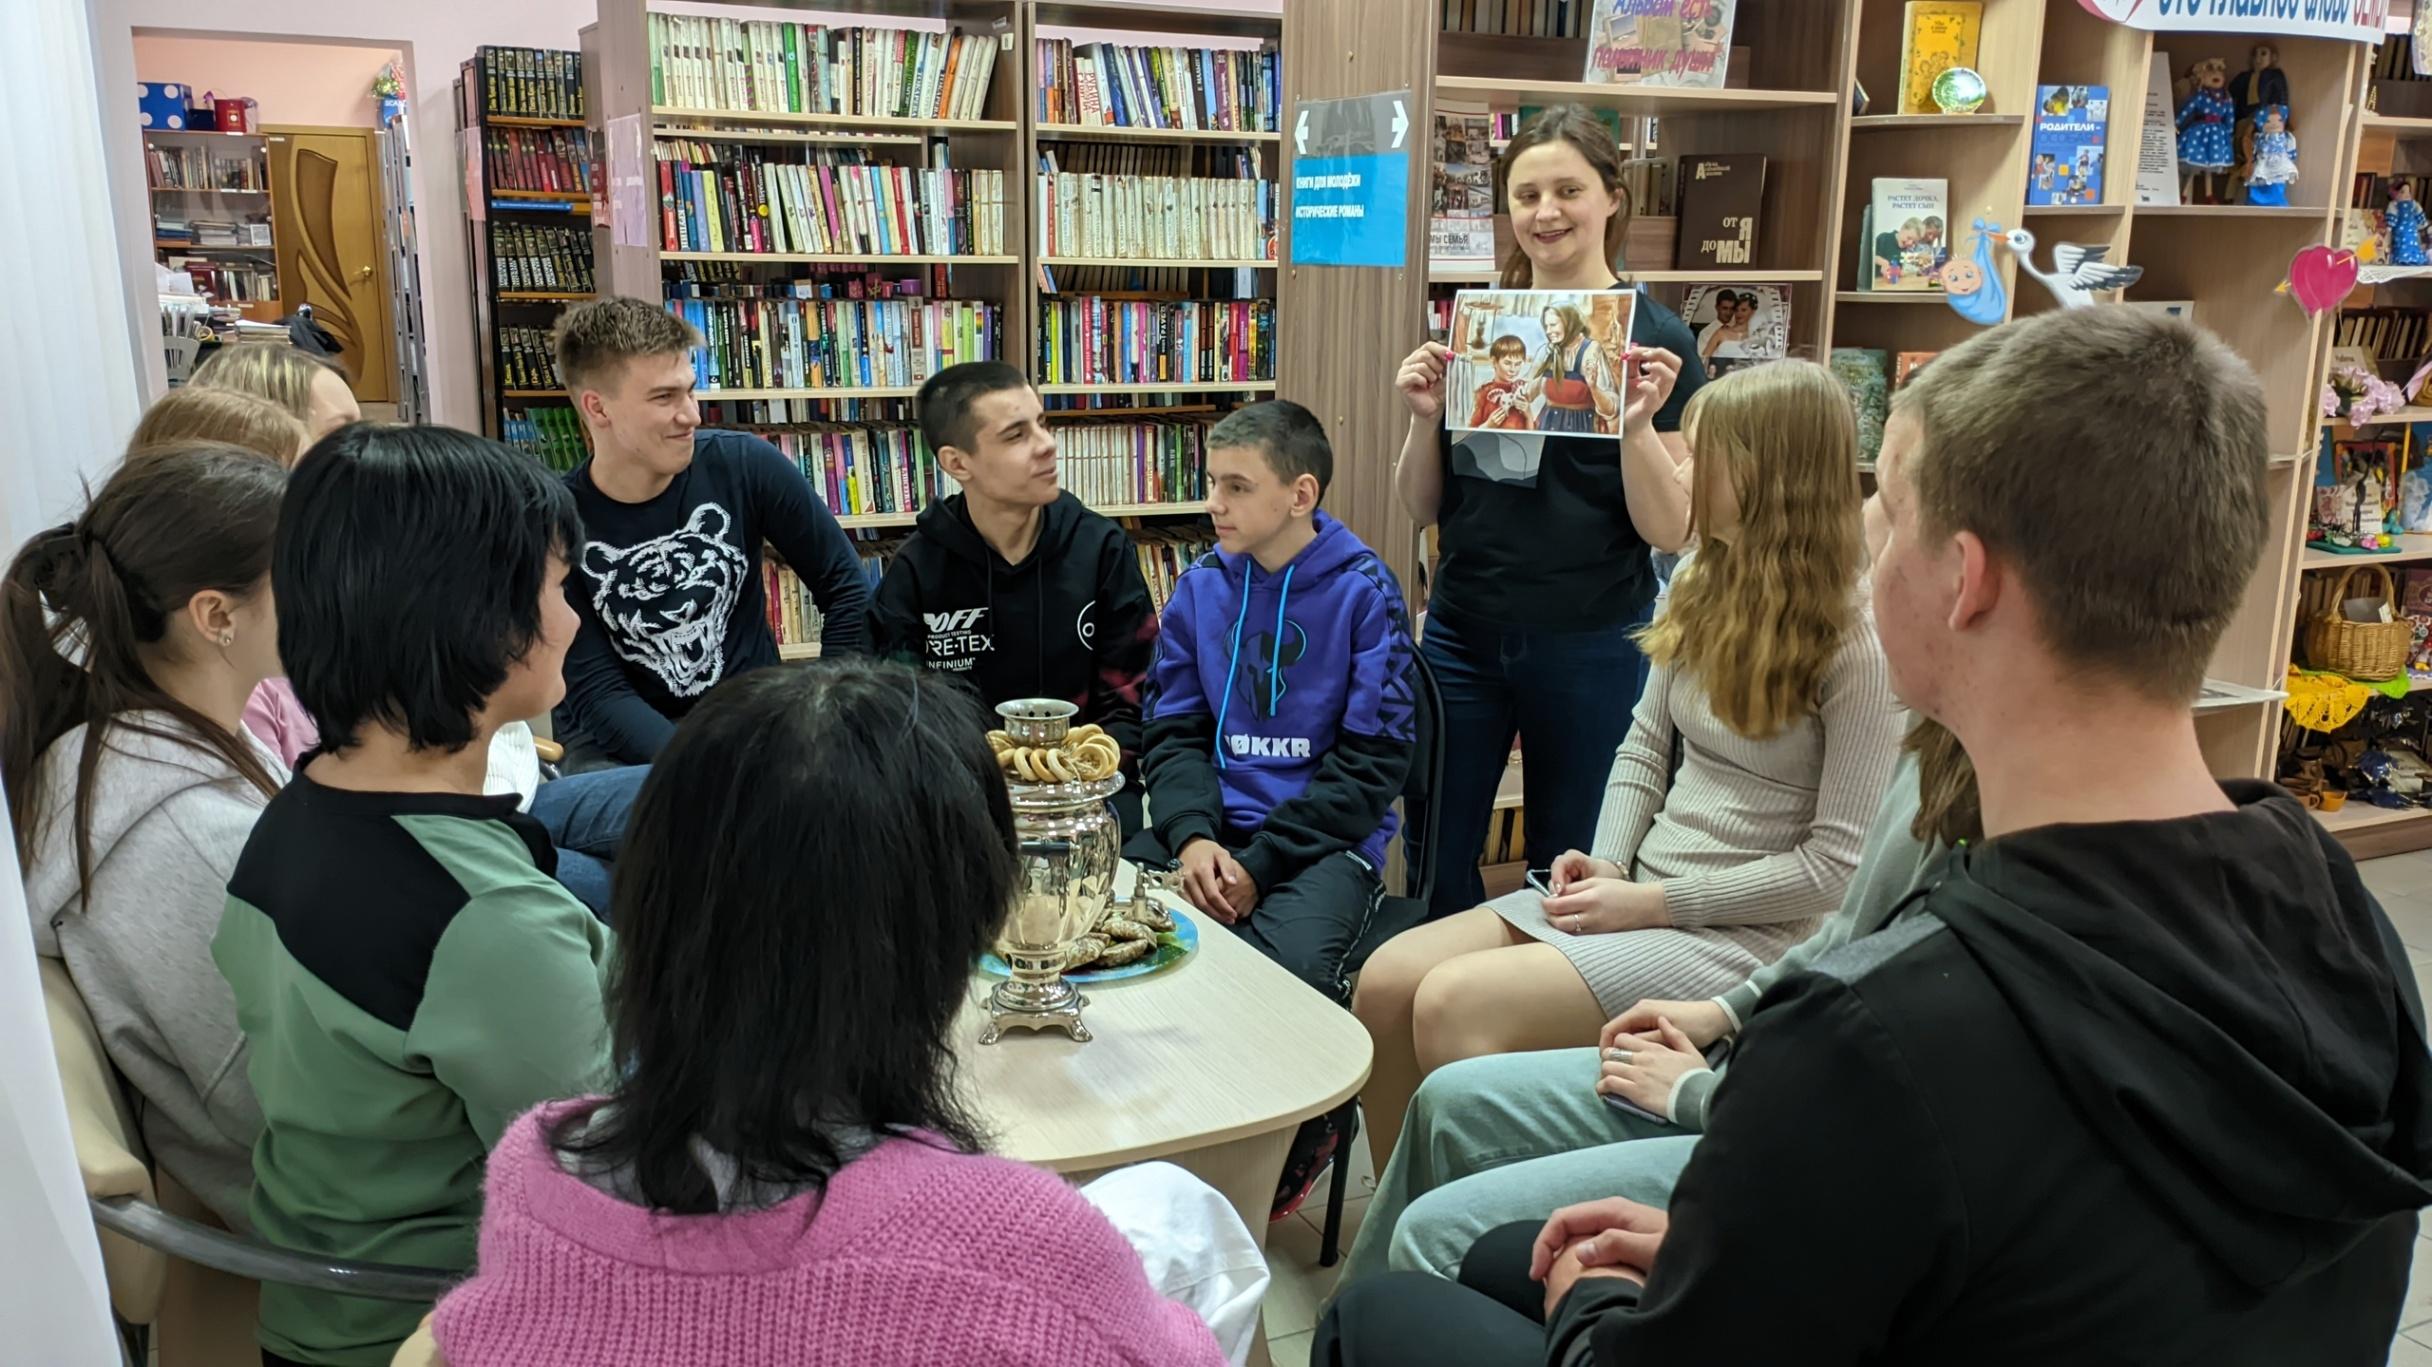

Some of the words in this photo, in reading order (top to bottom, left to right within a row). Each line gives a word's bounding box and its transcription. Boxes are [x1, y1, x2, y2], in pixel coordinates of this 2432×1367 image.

[2039, 122, 2095, 132] РОДИТЕЛИ
[1313, 175, 1327, 191] ДЛЯ
[1295, 204, 1339, 218] ИСТОРИЧЕСКИЕ
[1339, 204, 1364, 218] РОМАНЫ
[1738, 217, 1754, 240] Я
[1443, 232, 1469, 245] СЕМЬЯ
[1716, 240, 1752, 264] МЫ
